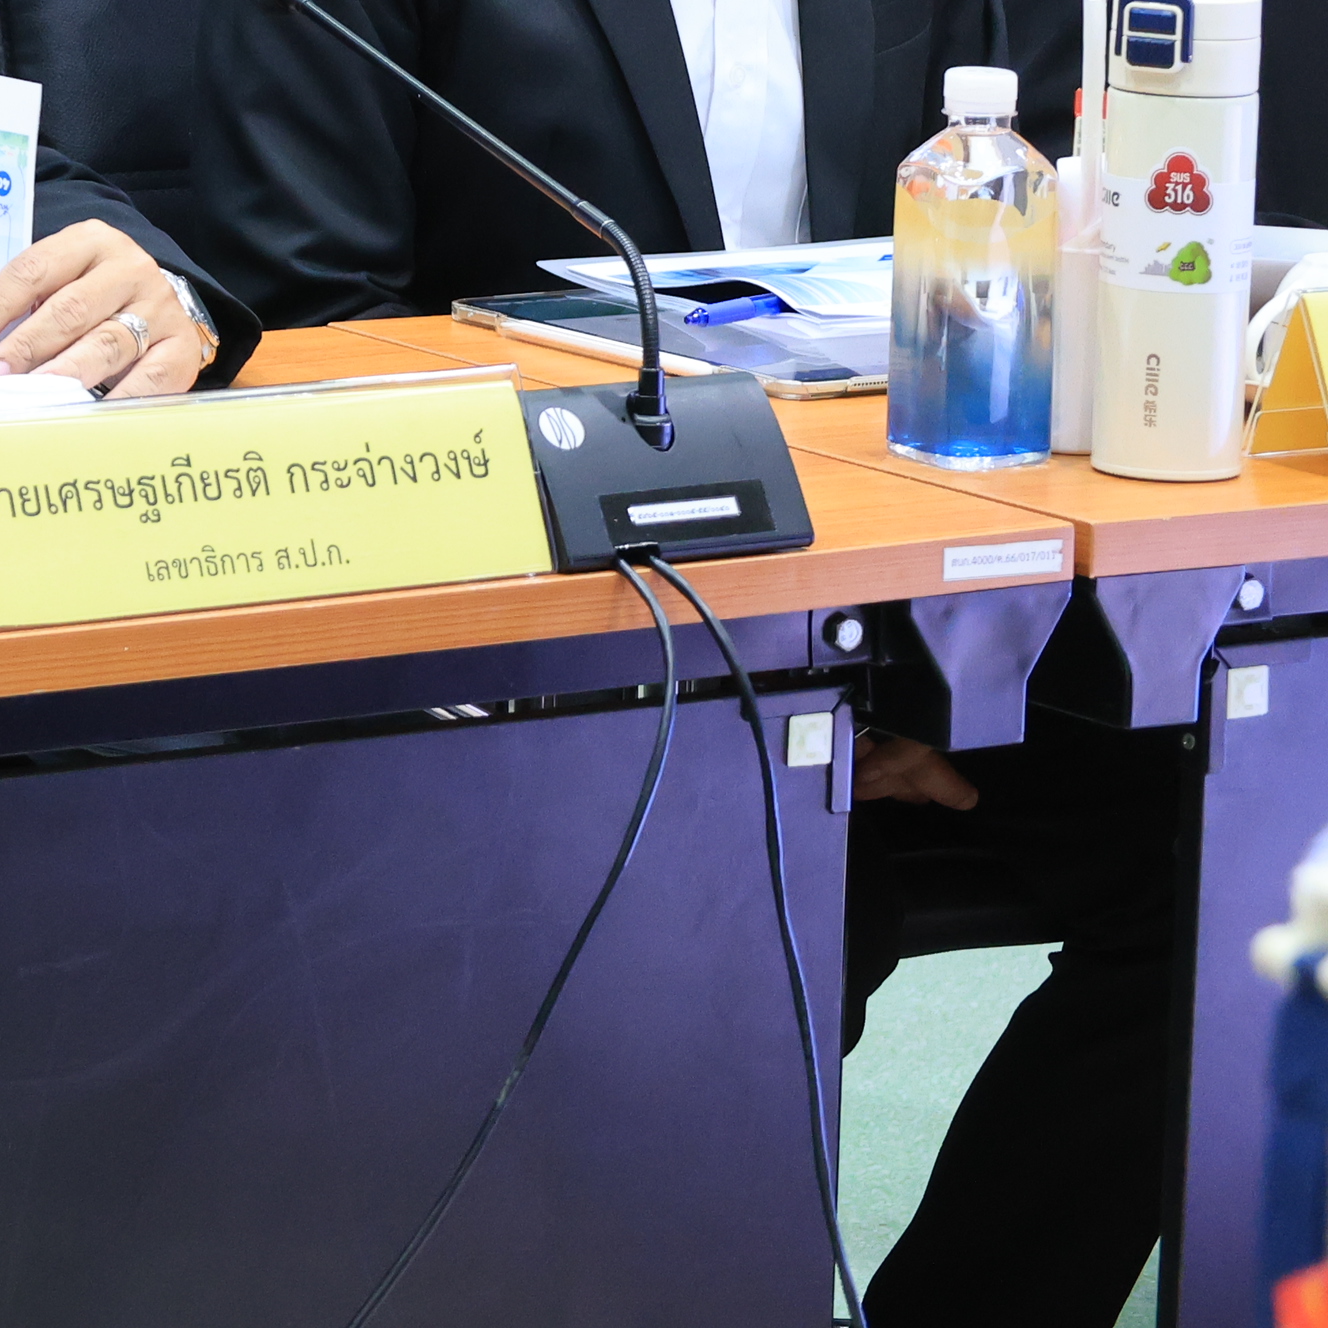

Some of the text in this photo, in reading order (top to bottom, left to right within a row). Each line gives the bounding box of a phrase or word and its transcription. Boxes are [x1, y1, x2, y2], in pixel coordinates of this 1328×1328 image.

[1164, 183, 1194, 204] 316
[1170, 172, 1191, 183] SUS
[1144, 353, 1161, 397] Cille
[286, 429, 492, 494] กระจ่างวงษ์
[144, 536, 351, 584] เลขาธิการ ส.ป.ก.
